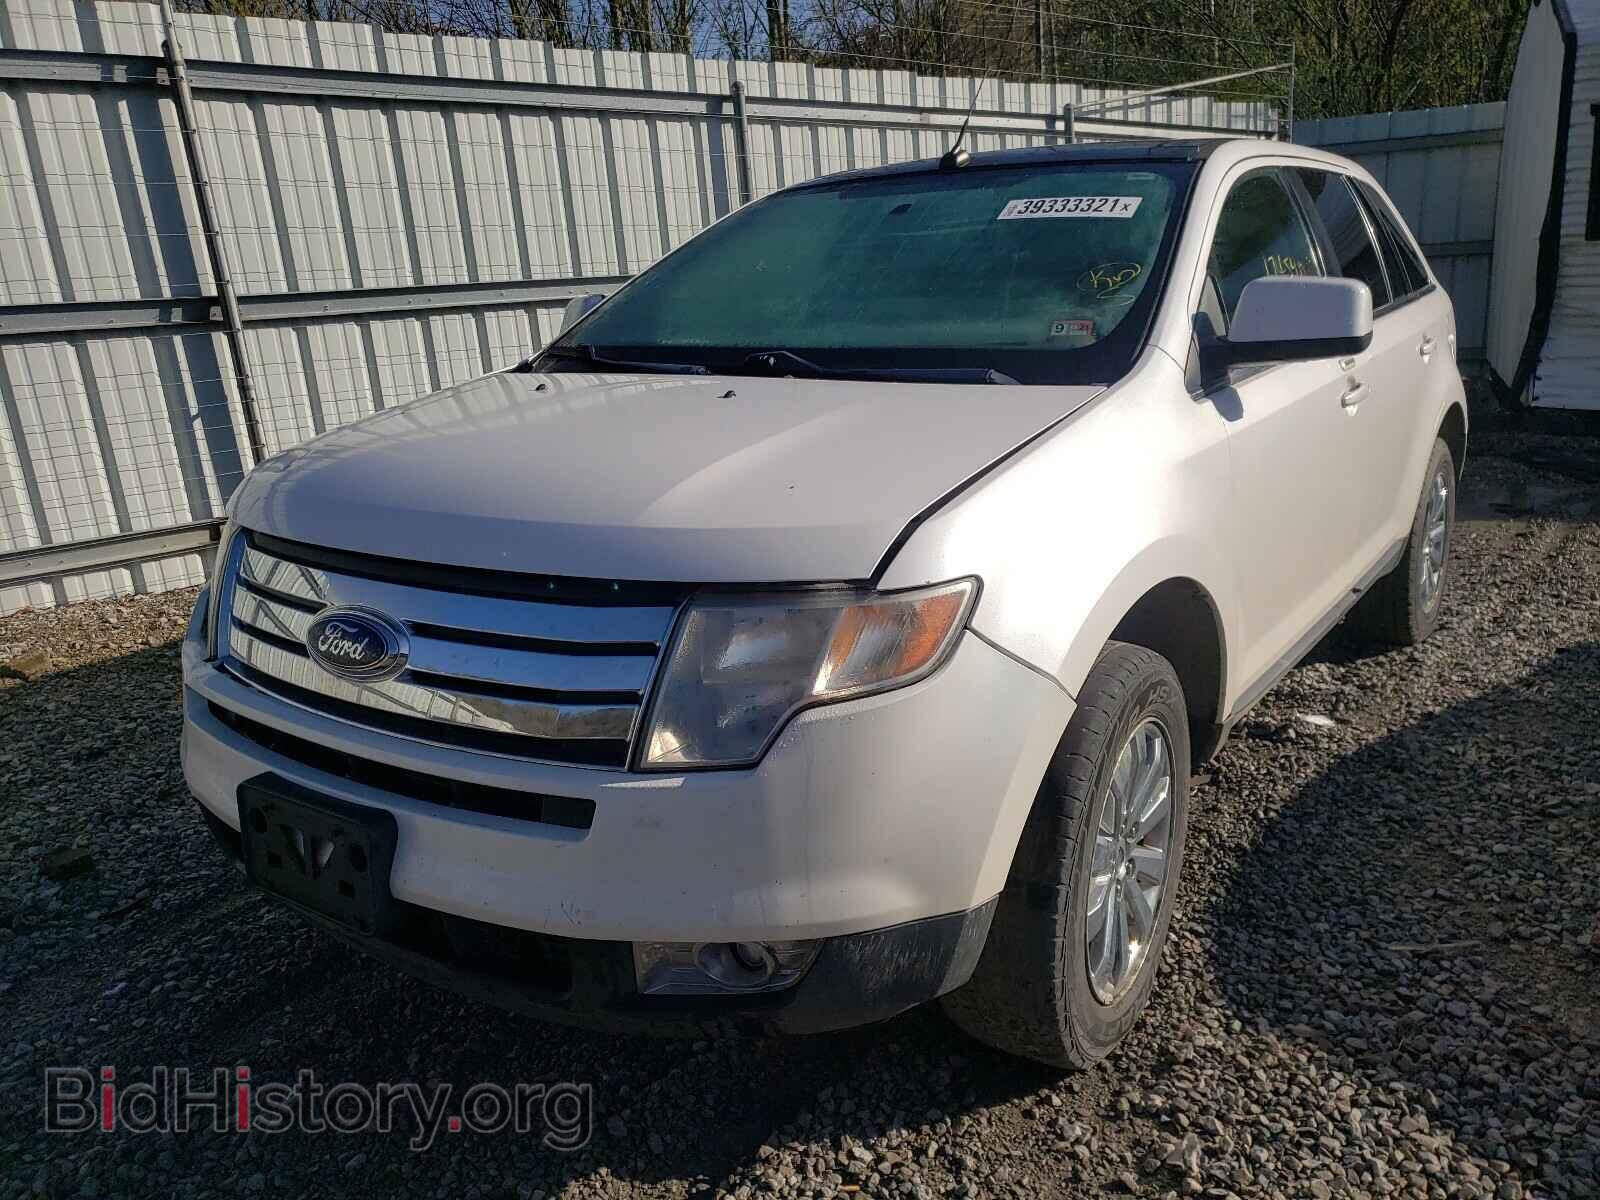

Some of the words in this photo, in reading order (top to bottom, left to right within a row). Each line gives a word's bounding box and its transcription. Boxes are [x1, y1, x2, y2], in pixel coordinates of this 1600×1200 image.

[1017, 198, 1120, 215] 39333321
[1055, 323, 1065, 333] 9
[318, 621, 369, 660] Ford
